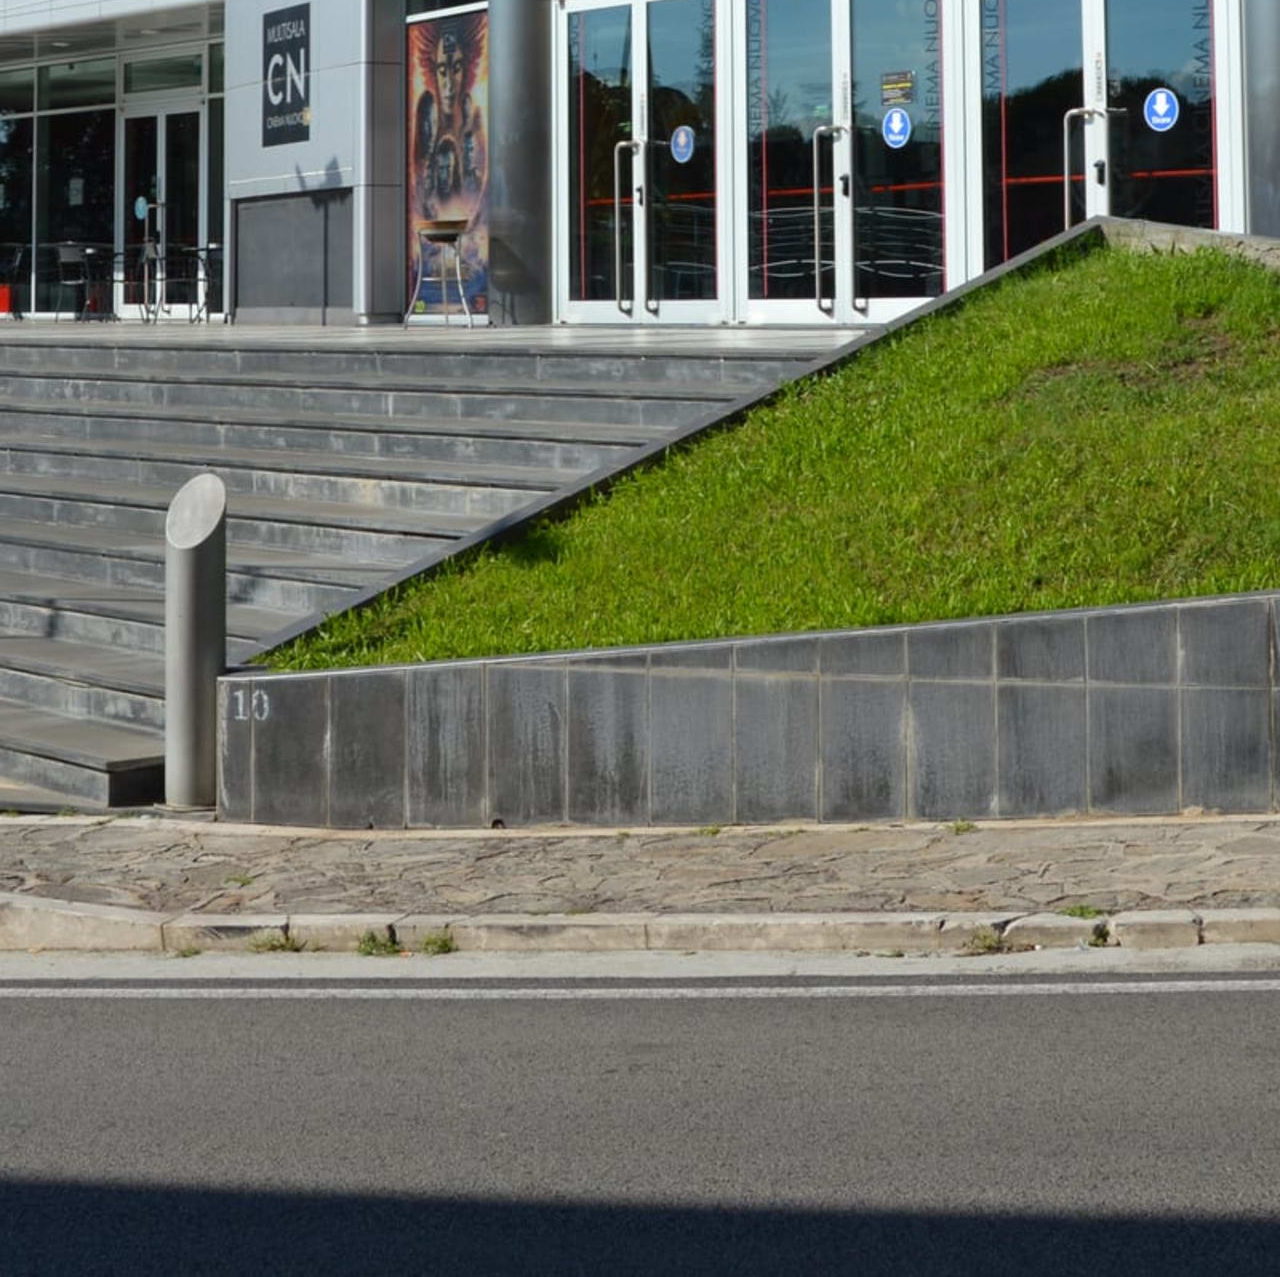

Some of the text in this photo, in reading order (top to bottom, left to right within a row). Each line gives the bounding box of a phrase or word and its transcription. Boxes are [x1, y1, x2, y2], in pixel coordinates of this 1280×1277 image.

[266, 19, 306, 44] MULTISALA
[267, 48, 306, 106] CN
[233, 689, 270, 721] 10
